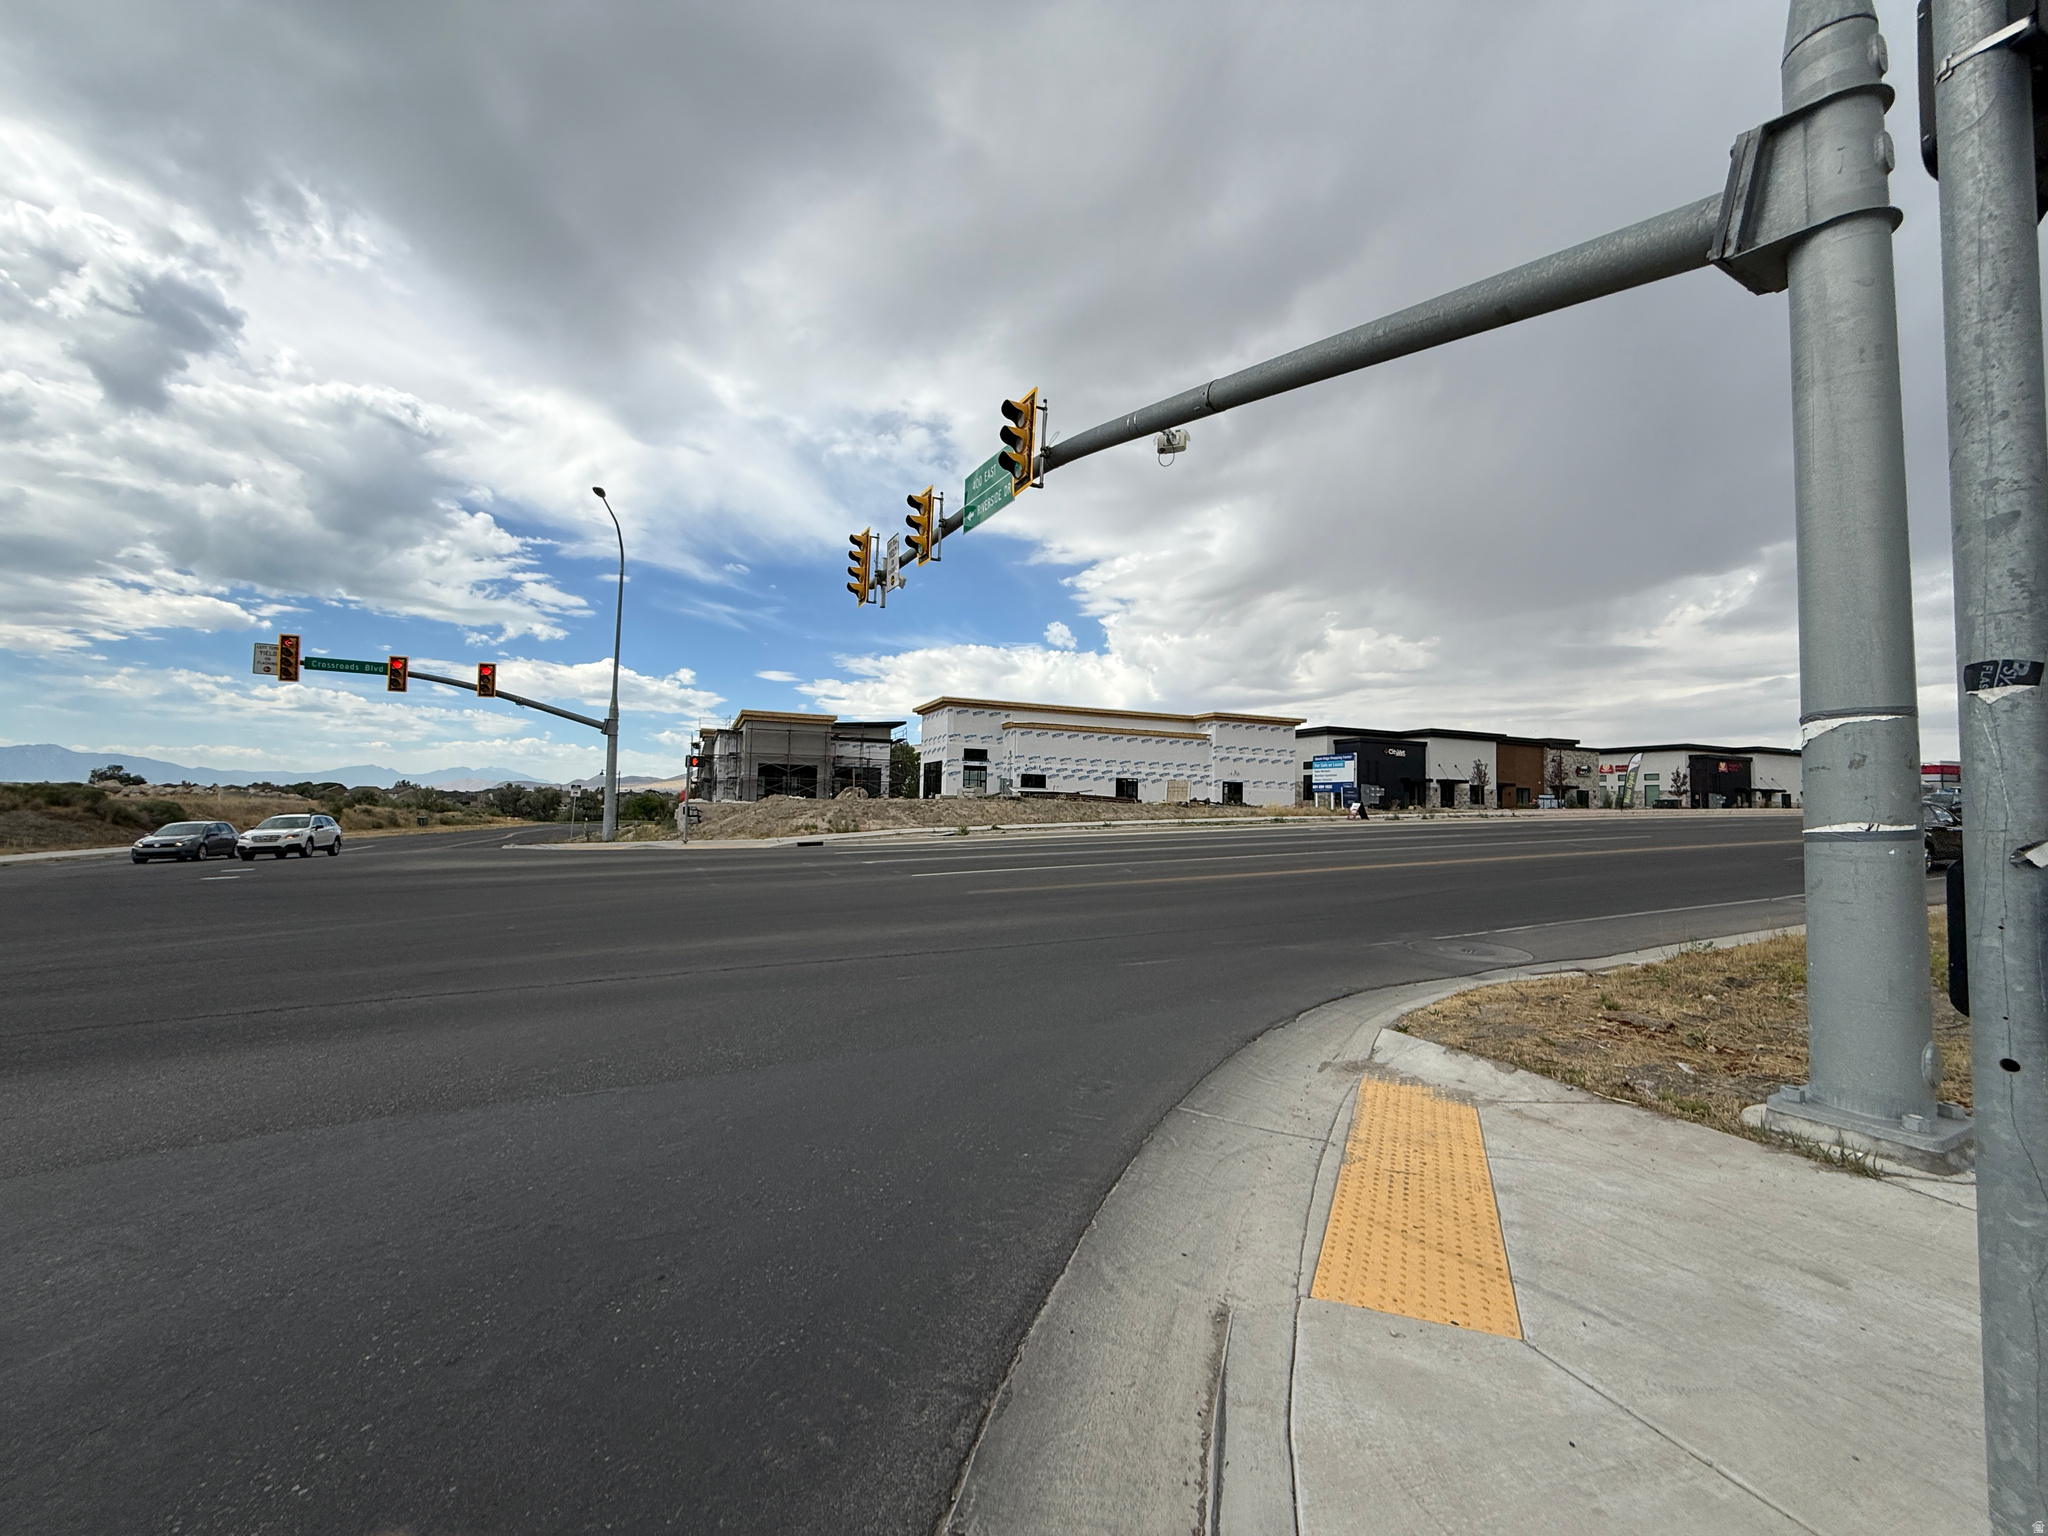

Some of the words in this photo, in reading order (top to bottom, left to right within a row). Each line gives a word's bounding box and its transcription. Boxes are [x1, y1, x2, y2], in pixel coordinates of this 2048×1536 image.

[972, 476, 982, 490] 400
[984, 464, 996, 482] EAST
[977, 489, 1002, 516] RIVERSIDE
[1004, 483, 1011, 497] DR
[312, 660, 360, 671] Crossroads
[365, 664, 384, 673] Blvd
